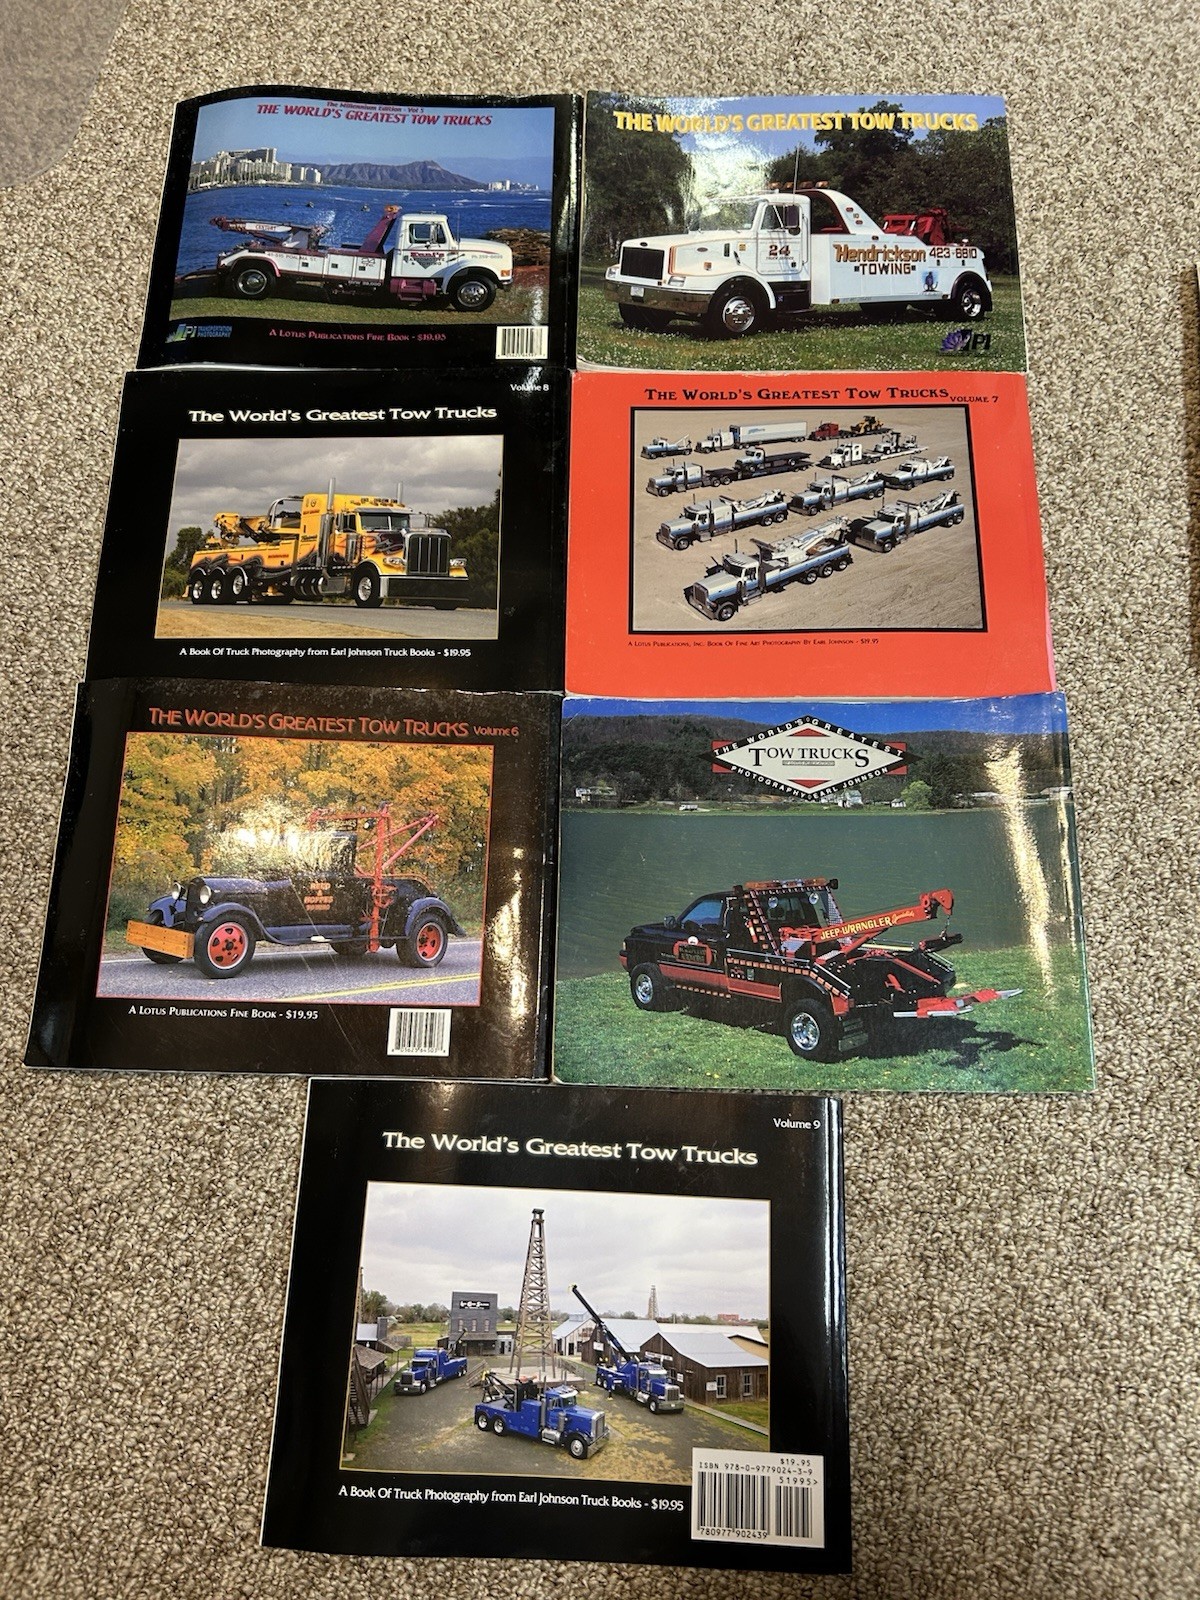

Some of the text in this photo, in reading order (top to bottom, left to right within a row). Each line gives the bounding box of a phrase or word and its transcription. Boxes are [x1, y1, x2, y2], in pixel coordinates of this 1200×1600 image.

[340, 103, 377, 111] Millennium
[257, 104, 493, 126] THE WORLD'S GREATEST TOW TRUCKS
[613, 110, 979, 134] THE WORLD'S GREATEST TOW TRUCKS
[769, 244, 790, 256] 24
[833, 244, 926, 262] Hendrickson
[860, 263, 911, 275] TOWING
[269, 328, 277, 336] A
[280, 330, 306, 338] LOTUS
[308, 331, 364, 341] PUBLICATIONS
[366, 333, 384, 342] FINE
[387, 334, 410, 342] BOOK
[542, 384, 550, 392] 8
[644, 386, 950, 400] THE WORLD'S GREATEST TOW TRUCKS
[188, 406, 498, 422] The World's Greatest Tow Trucks
[189, 648, 211, 656] Book
[212, 648, 224, 656] Of
[252, 648, 306, 658] Photography
[307, 648, 329, 656] from
[330, 648, 346, 656] Earl
[347, 648, 382, 658] Johnson
[384, 648, 408, 656] Truck
[410, 648, 436, 656] Books
[443, 648, 472, 657] $19.95
[149, 708, 520, 738] THE WORLD'S GREATEST TOW TRUCKS Volume 6
[713, 718, 903, 757] THE WORLD'S GREATEST
[748, 747, 870, 768] TOW TRUCKS
[730, 765, 888, 800] PHOTOGRAPHY EARL JOHNSON
[128, 1006, 136, 1014] A
[138, 1006, 166, 1016] LOTUS
[169, 1006, 228, 1017] PUBLICATIONS
[230, 1008, 248, 1018] FINE
[251, 1009, 276, 1018] BOOK
[286, 1010, 318, 1020] $19.95
[772, 1118, 821, 1130] Volume 9
[382, 1132, 759, 1166] The World's Greatest Tow Trucks
[724, 1462, 813, 1476] 978-0-9779024-3-9
[780, 1458, 811, 1467] $19.95
[779, 1476, 818, 1486] 51995>
[338, 1485, 348, 1496] A
[350, 1486, 376, 1498] Book
[378, 1487, 392, 1498] Of
[394, 1488, 422, 1500] Truck
[424, 1488, 490, 1504] Photography
[491, 1490, 516, 1502] from
[518, 1492, 537, 1504] Earl
[538, 1492, 580, 1506] Johnson
[580, 1494, 610, 1507] Truck
[611, 1496, 642, 1508] Books
[651, 1498, 684, 1512] $19.95
